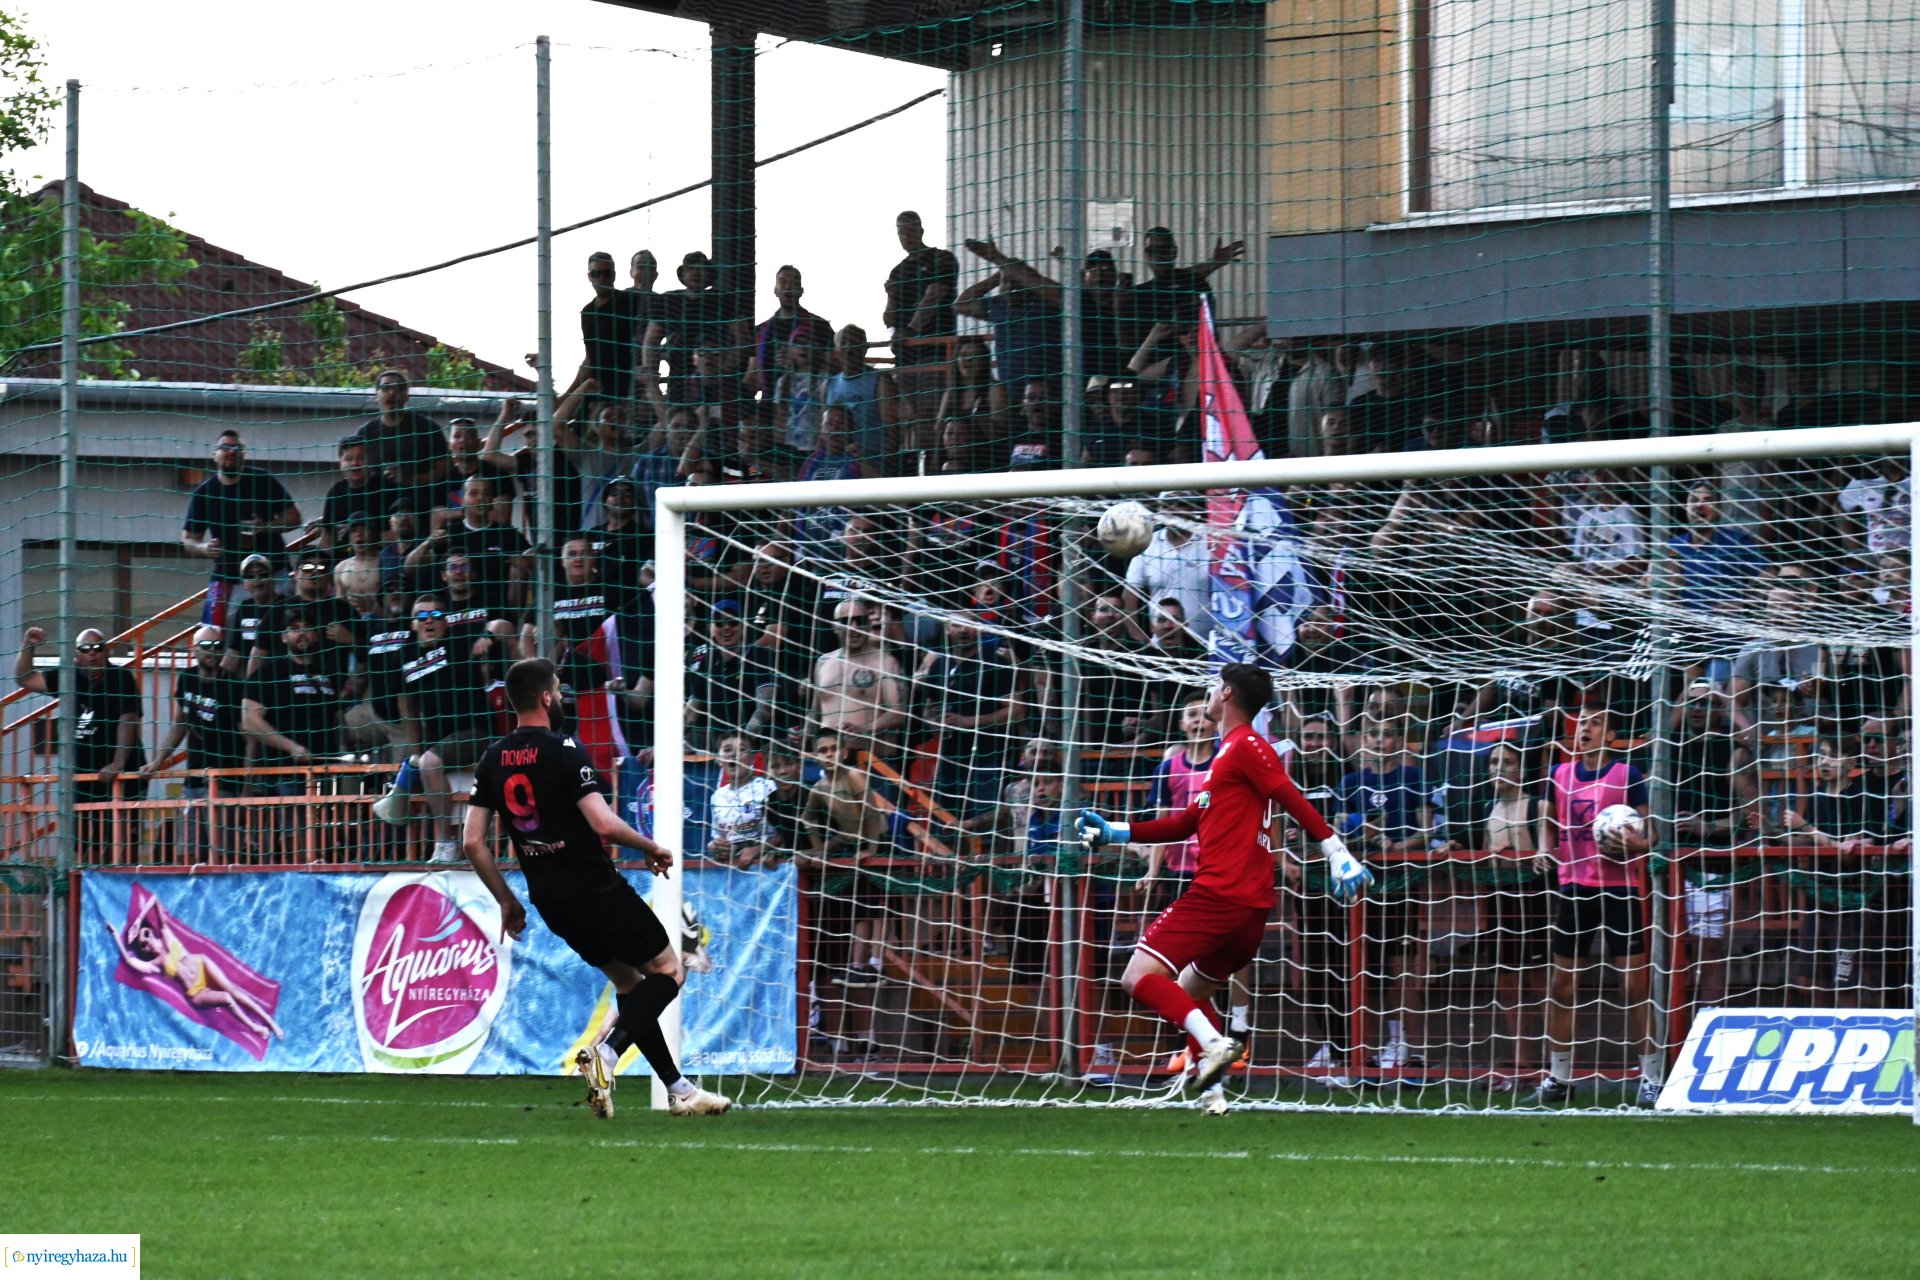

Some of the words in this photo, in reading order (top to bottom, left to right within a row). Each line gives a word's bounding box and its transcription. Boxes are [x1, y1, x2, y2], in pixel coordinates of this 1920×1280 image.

[501, 744, 539, 767] NOVÁK
[503, 773, 541, 832] 9
[362, 923, 498, 1047] Aquarius
[408, 985, 493, 1002] NYÍREGYHÁZA
